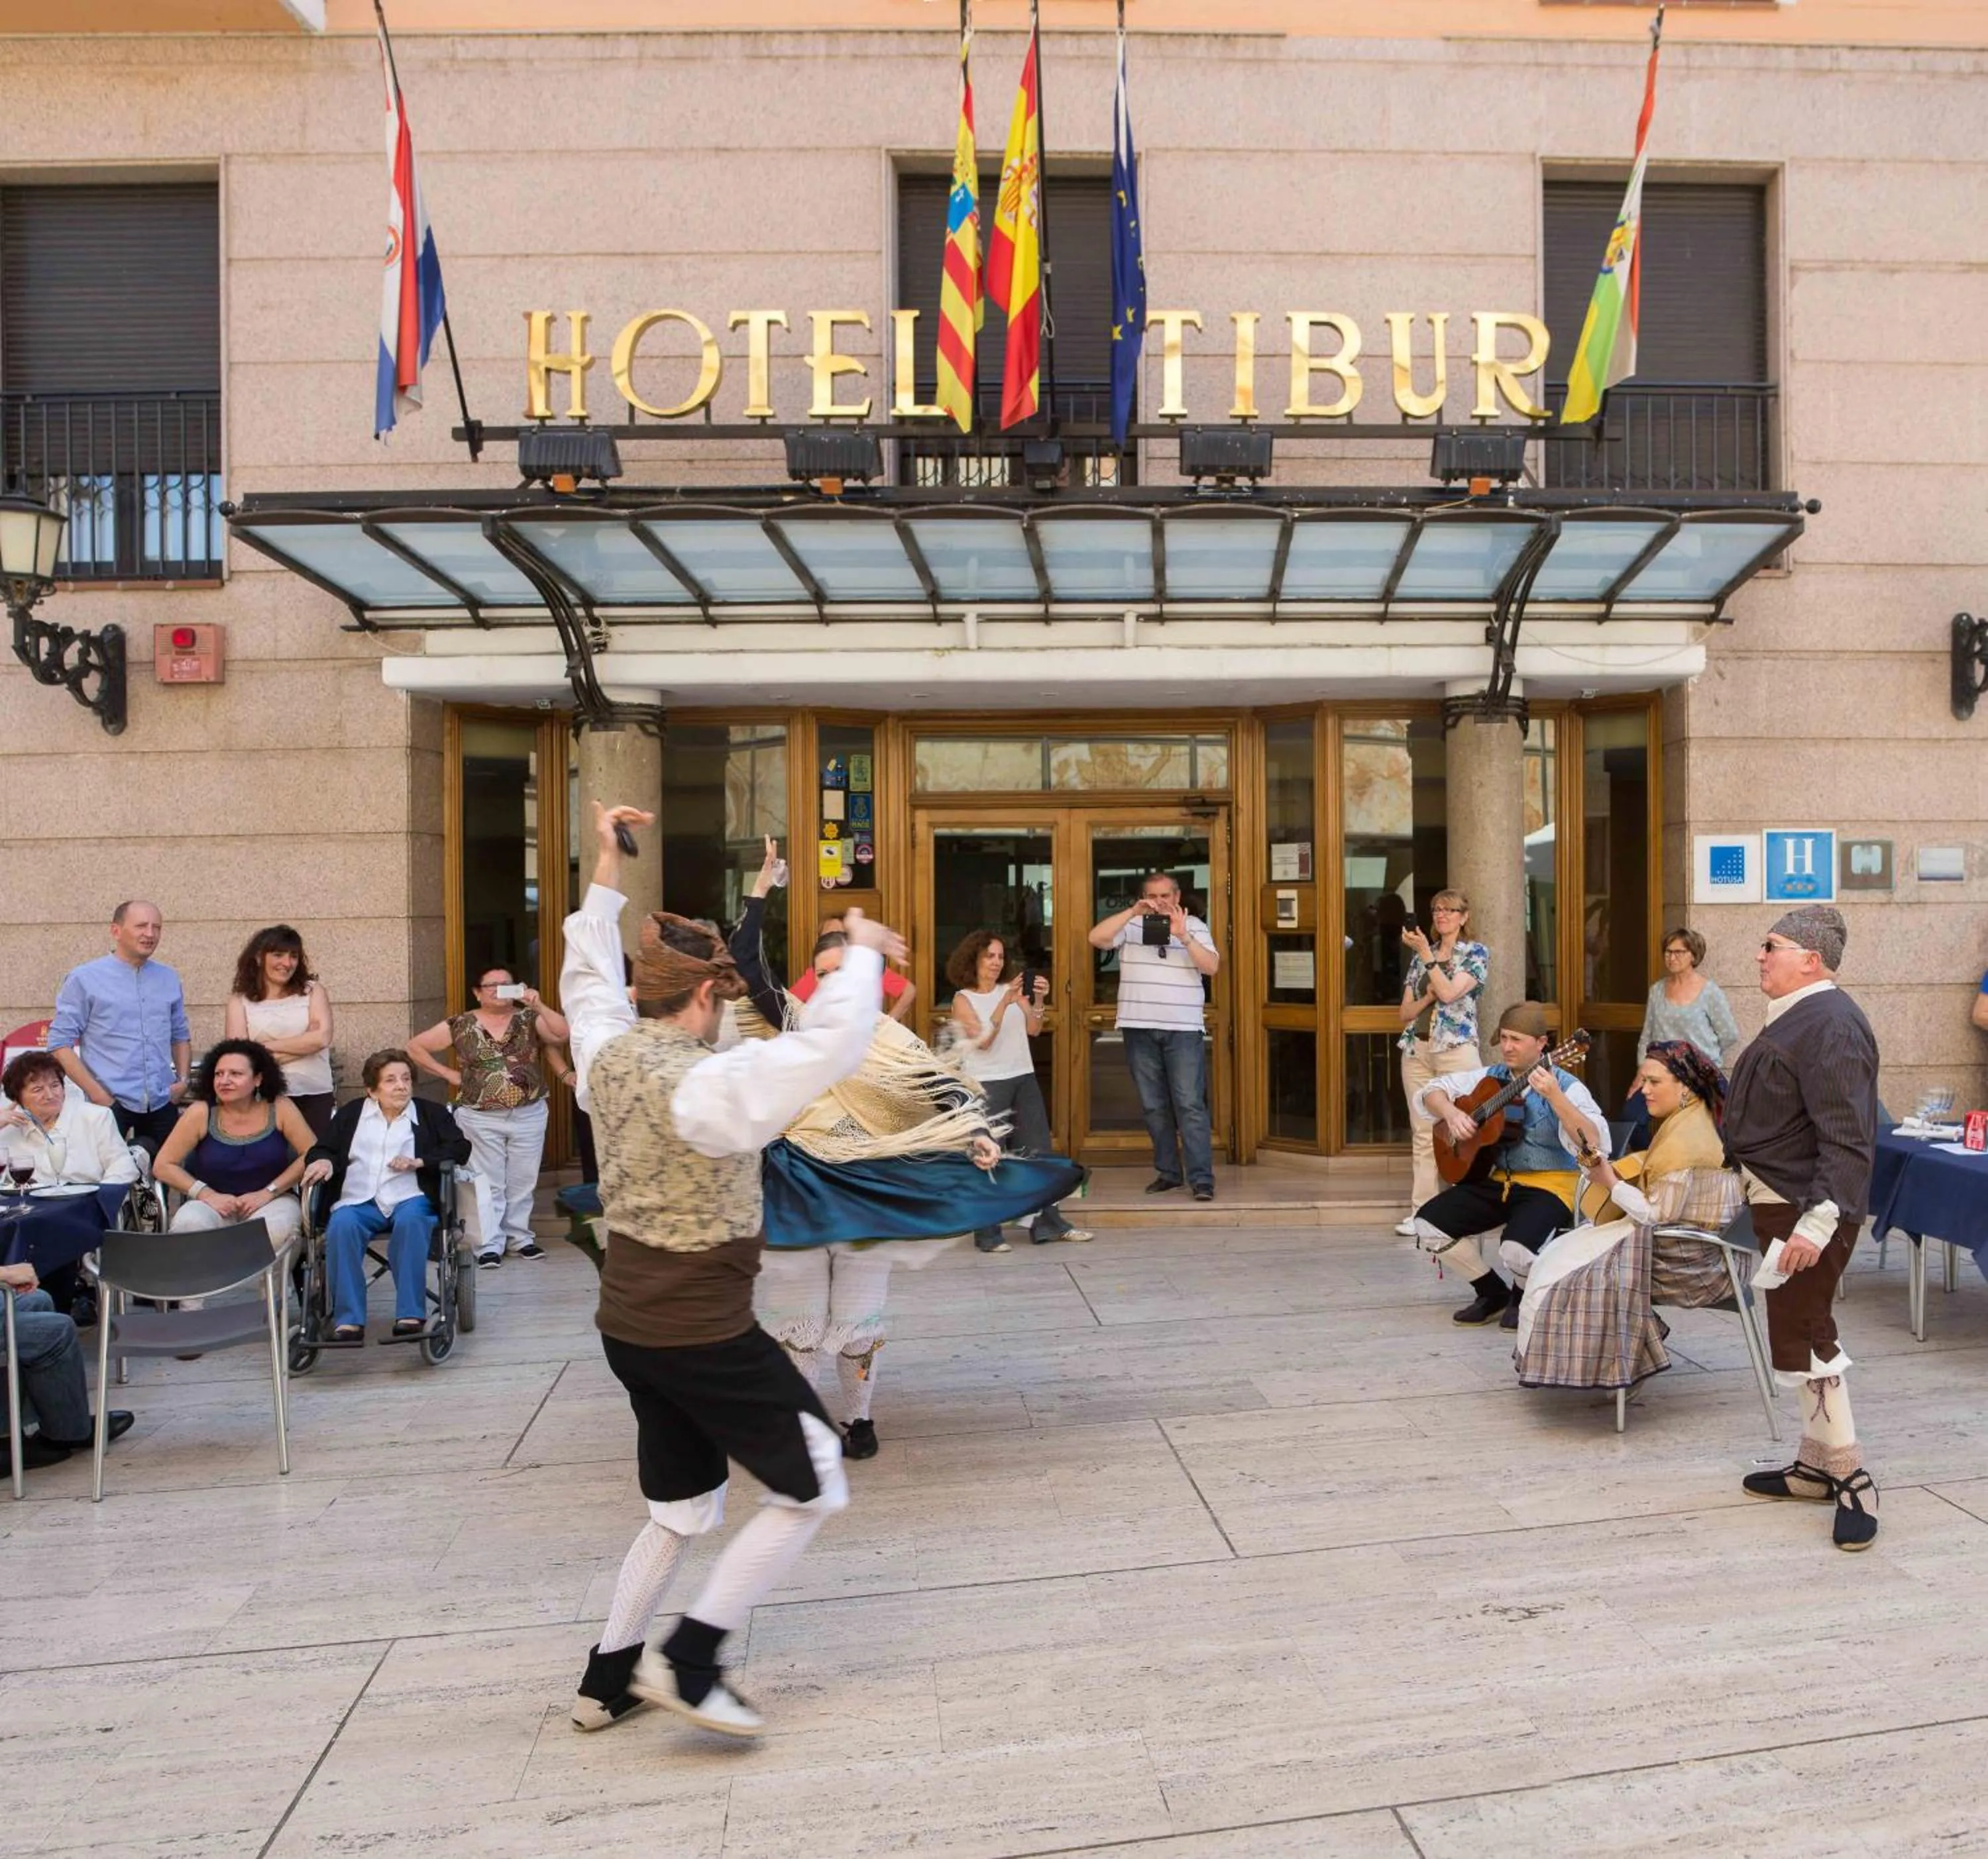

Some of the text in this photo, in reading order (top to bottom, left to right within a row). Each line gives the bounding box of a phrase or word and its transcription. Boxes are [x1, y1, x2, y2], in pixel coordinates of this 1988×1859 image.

[523, 309, 1553, 419] HOTEL TIBUR
[1783, 837, 1815, 875] H
[1710, 875, 1744, 884] HOTUSA
